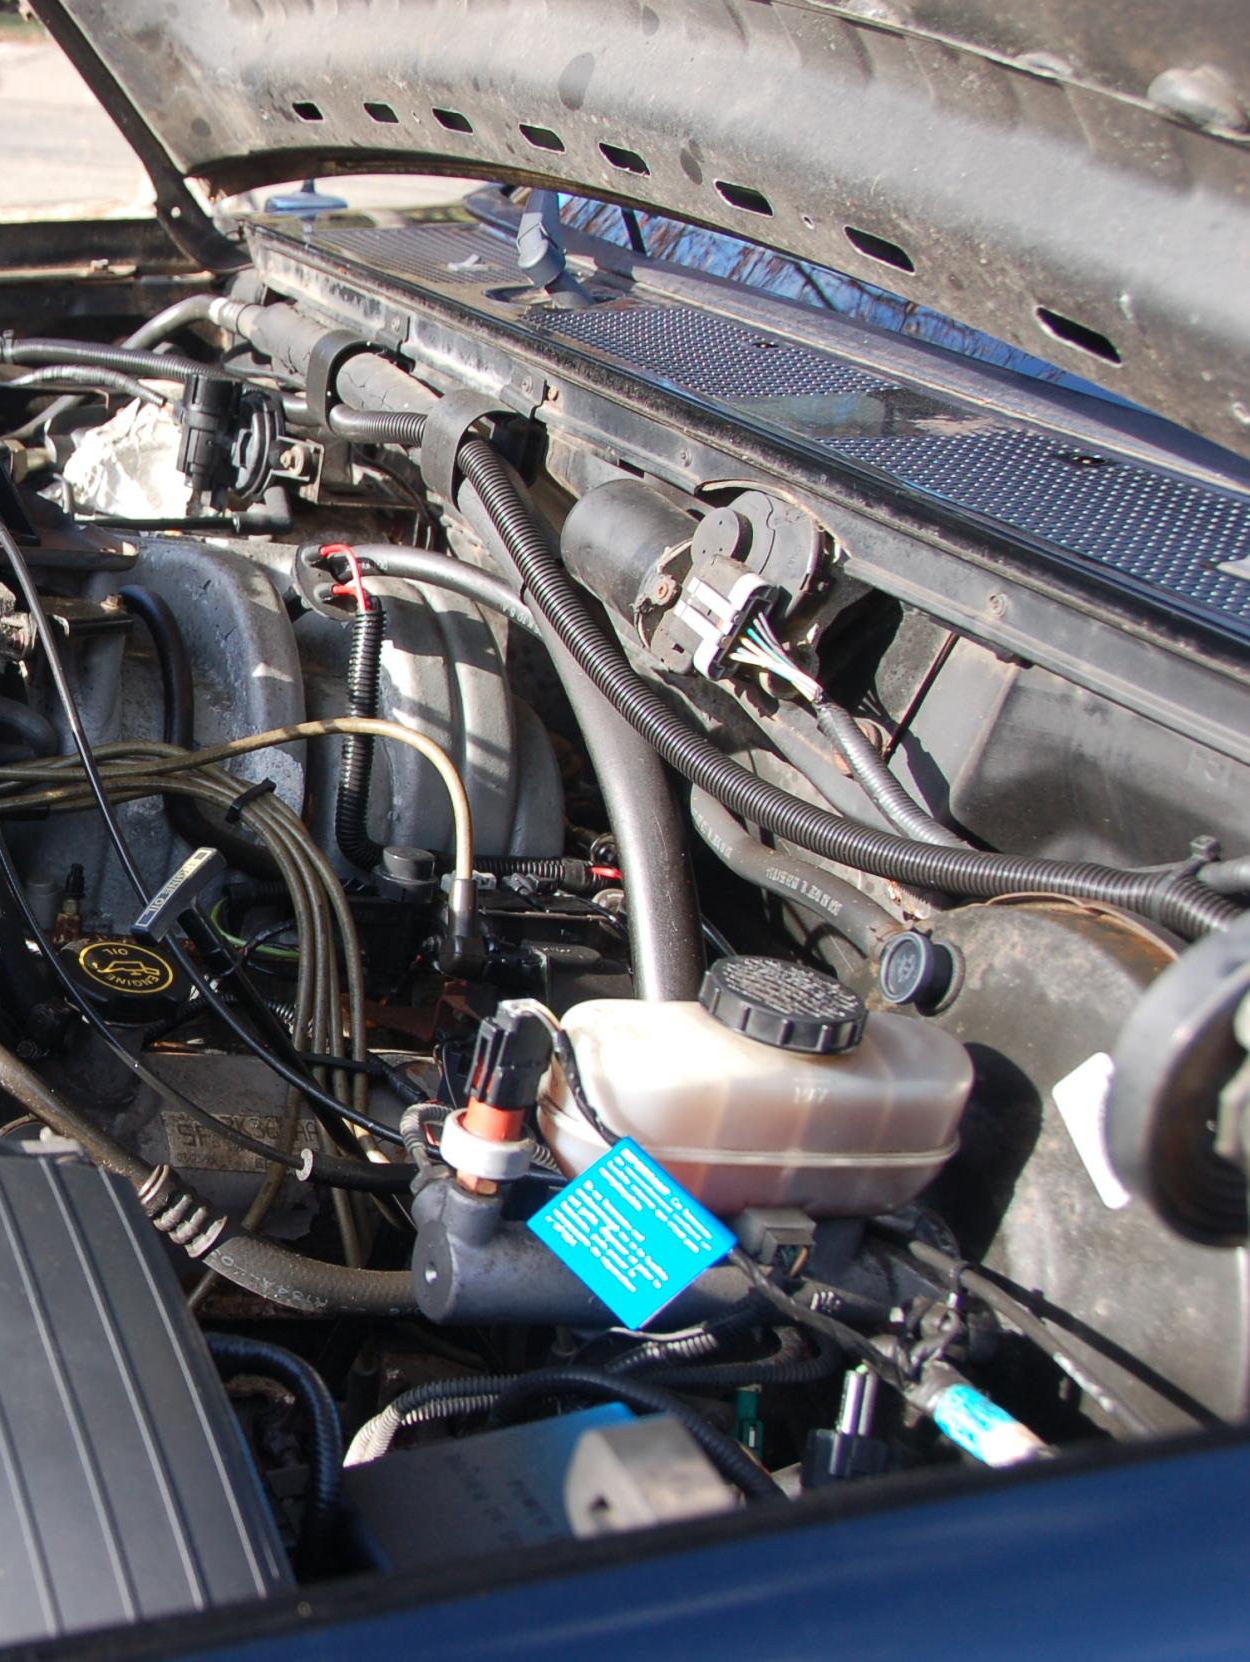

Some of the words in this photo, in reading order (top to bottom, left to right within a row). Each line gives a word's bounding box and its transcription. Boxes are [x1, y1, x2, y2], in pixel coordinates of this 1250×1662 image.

[165, 862, 196, 895] ENGINE
[149, 898, 164, 912] OIL
[103, 948, 129, 956] OIL
[107, 975, 160, 987] ENGINE
